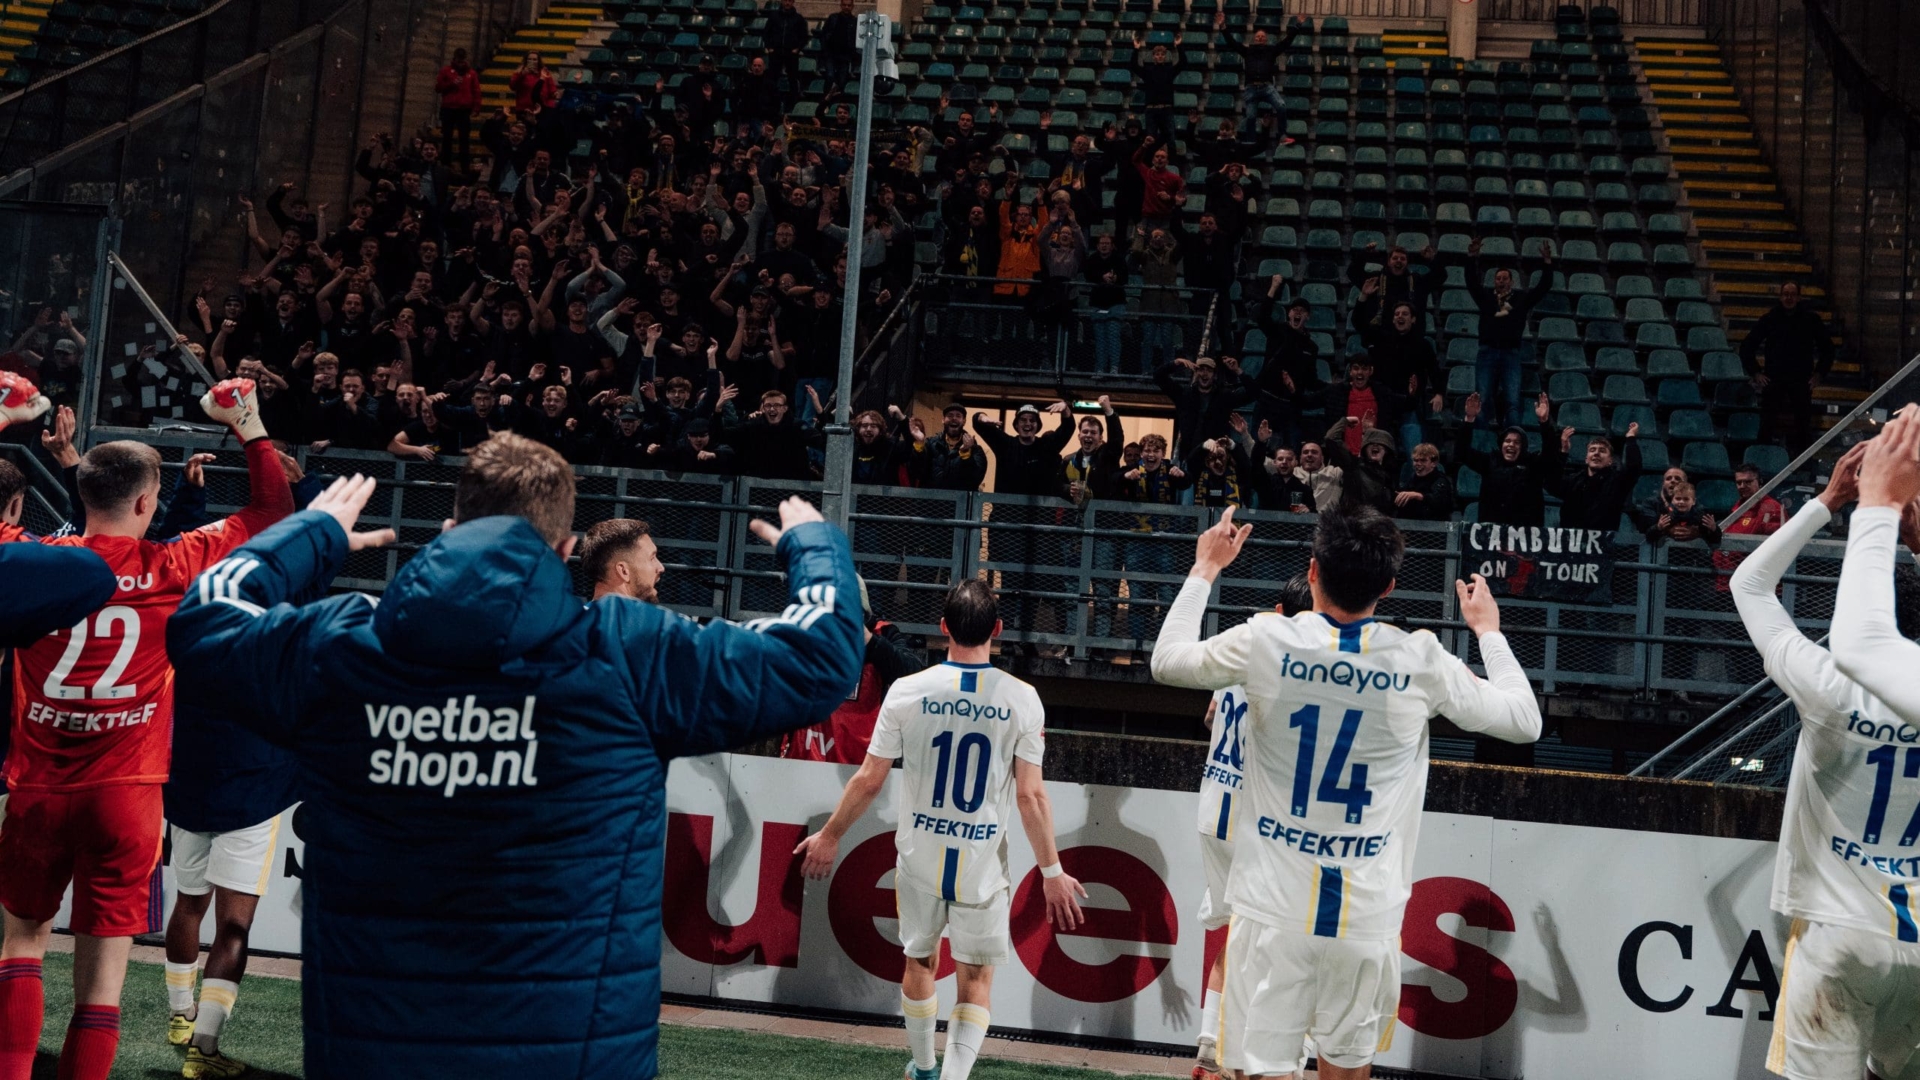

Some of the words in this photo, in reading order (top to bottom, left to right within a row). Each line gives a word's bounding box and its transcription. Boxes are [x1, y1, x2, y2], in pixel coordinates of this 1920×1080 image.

[1470, 523, 1603, 554] CAMBUUR
[1480, 560, 1507, 579] ON
[1539, 561, 1600, 583] TOUR
[43, 605, 141, 699] 22
[1281, 653, 1411, 694] tanQyou
[28, 701, 158, 731] EFFEKTIEF
[365, 695, 537, 742] voetbal
[922, 697, 1011, 721] tanQyou
[368, 740, 538, 797] shop.nl
[932, 731, 992, 813] 10
[1202, 764, 1244, 790] EFFEKT
[1289, 704, 1373, 824] 14
[913, 813, 998, 840] FFEKTIEF
[1258, 815, 1391, 859] EFFEKTIE
